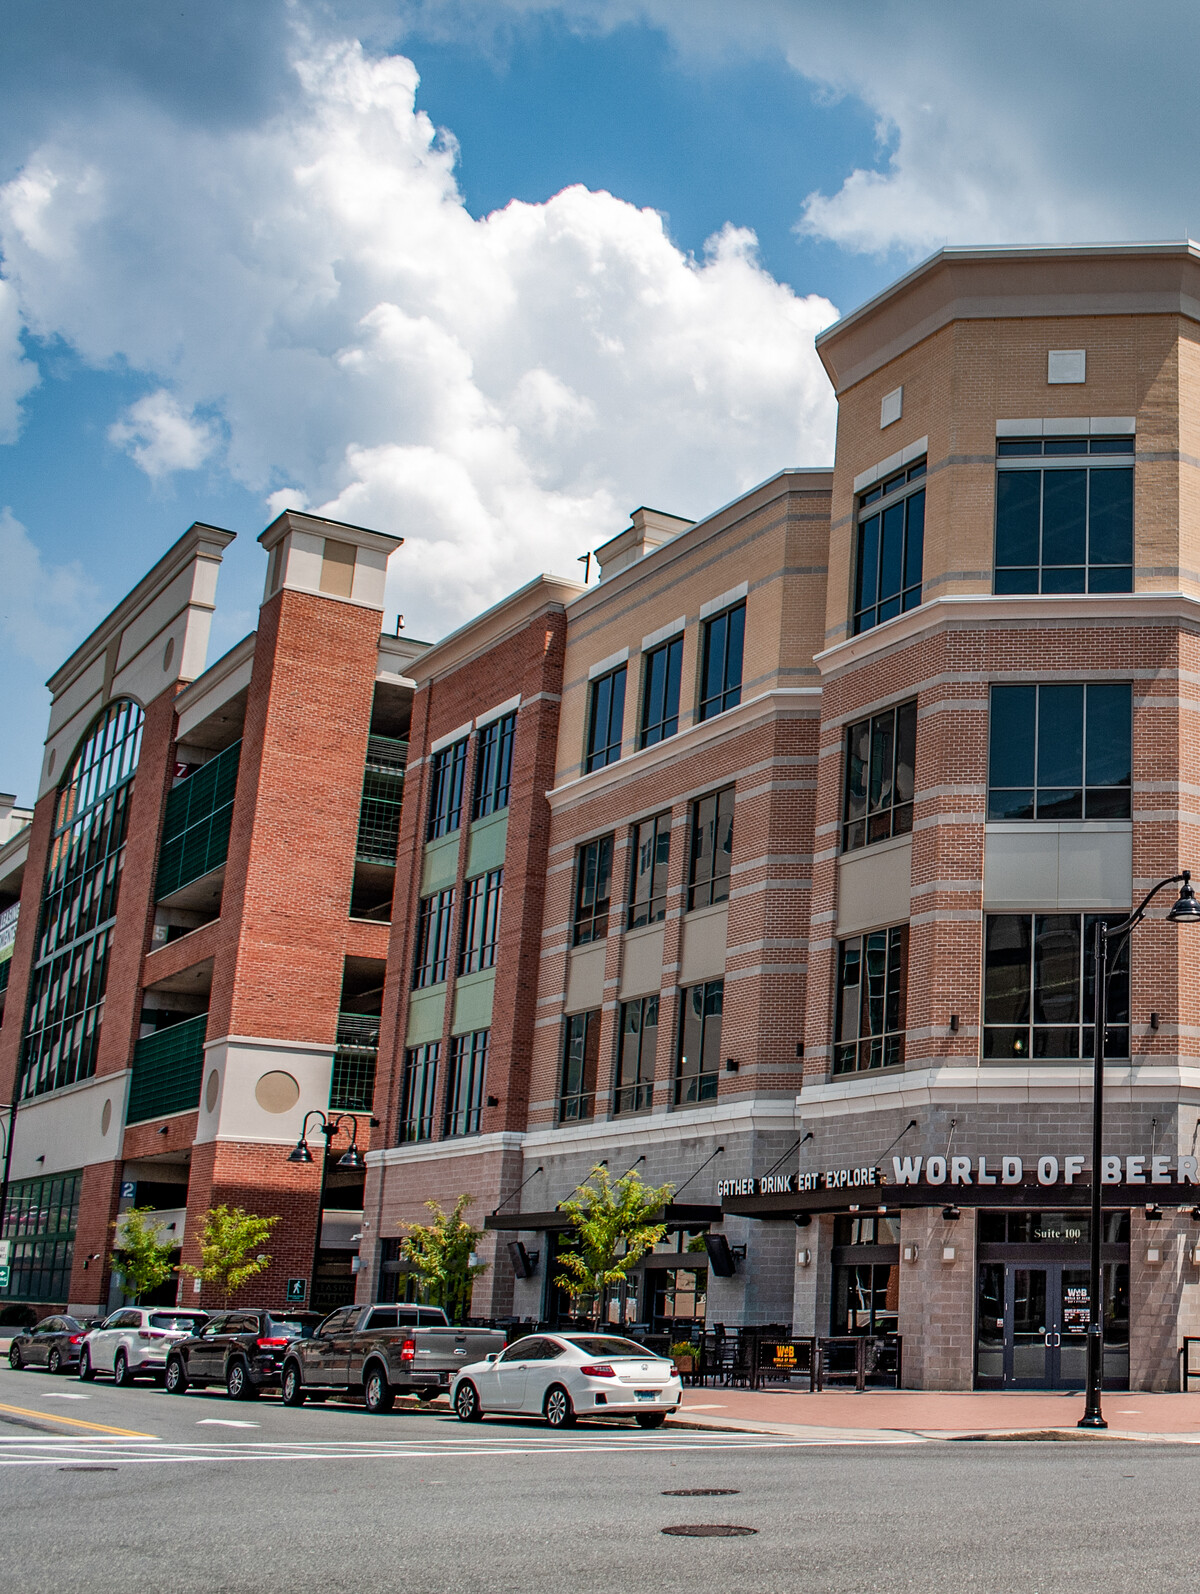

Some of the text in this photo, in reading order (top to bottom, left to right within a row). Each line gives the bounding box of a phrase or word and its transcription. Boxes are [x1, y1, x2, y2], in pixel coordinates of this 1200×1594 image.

[177, 763, 188, 777] 7
[155, 926, 166, 940] 5
[892, 1155, 1199, 1186] WORLD OF BEER
[717, 1167, 876, 1197] GATHER DRINK EAT EXPLORE
[123, 1182, 135, 1198] 2
[1033, 1228, 1081, 1239] Suite 100
